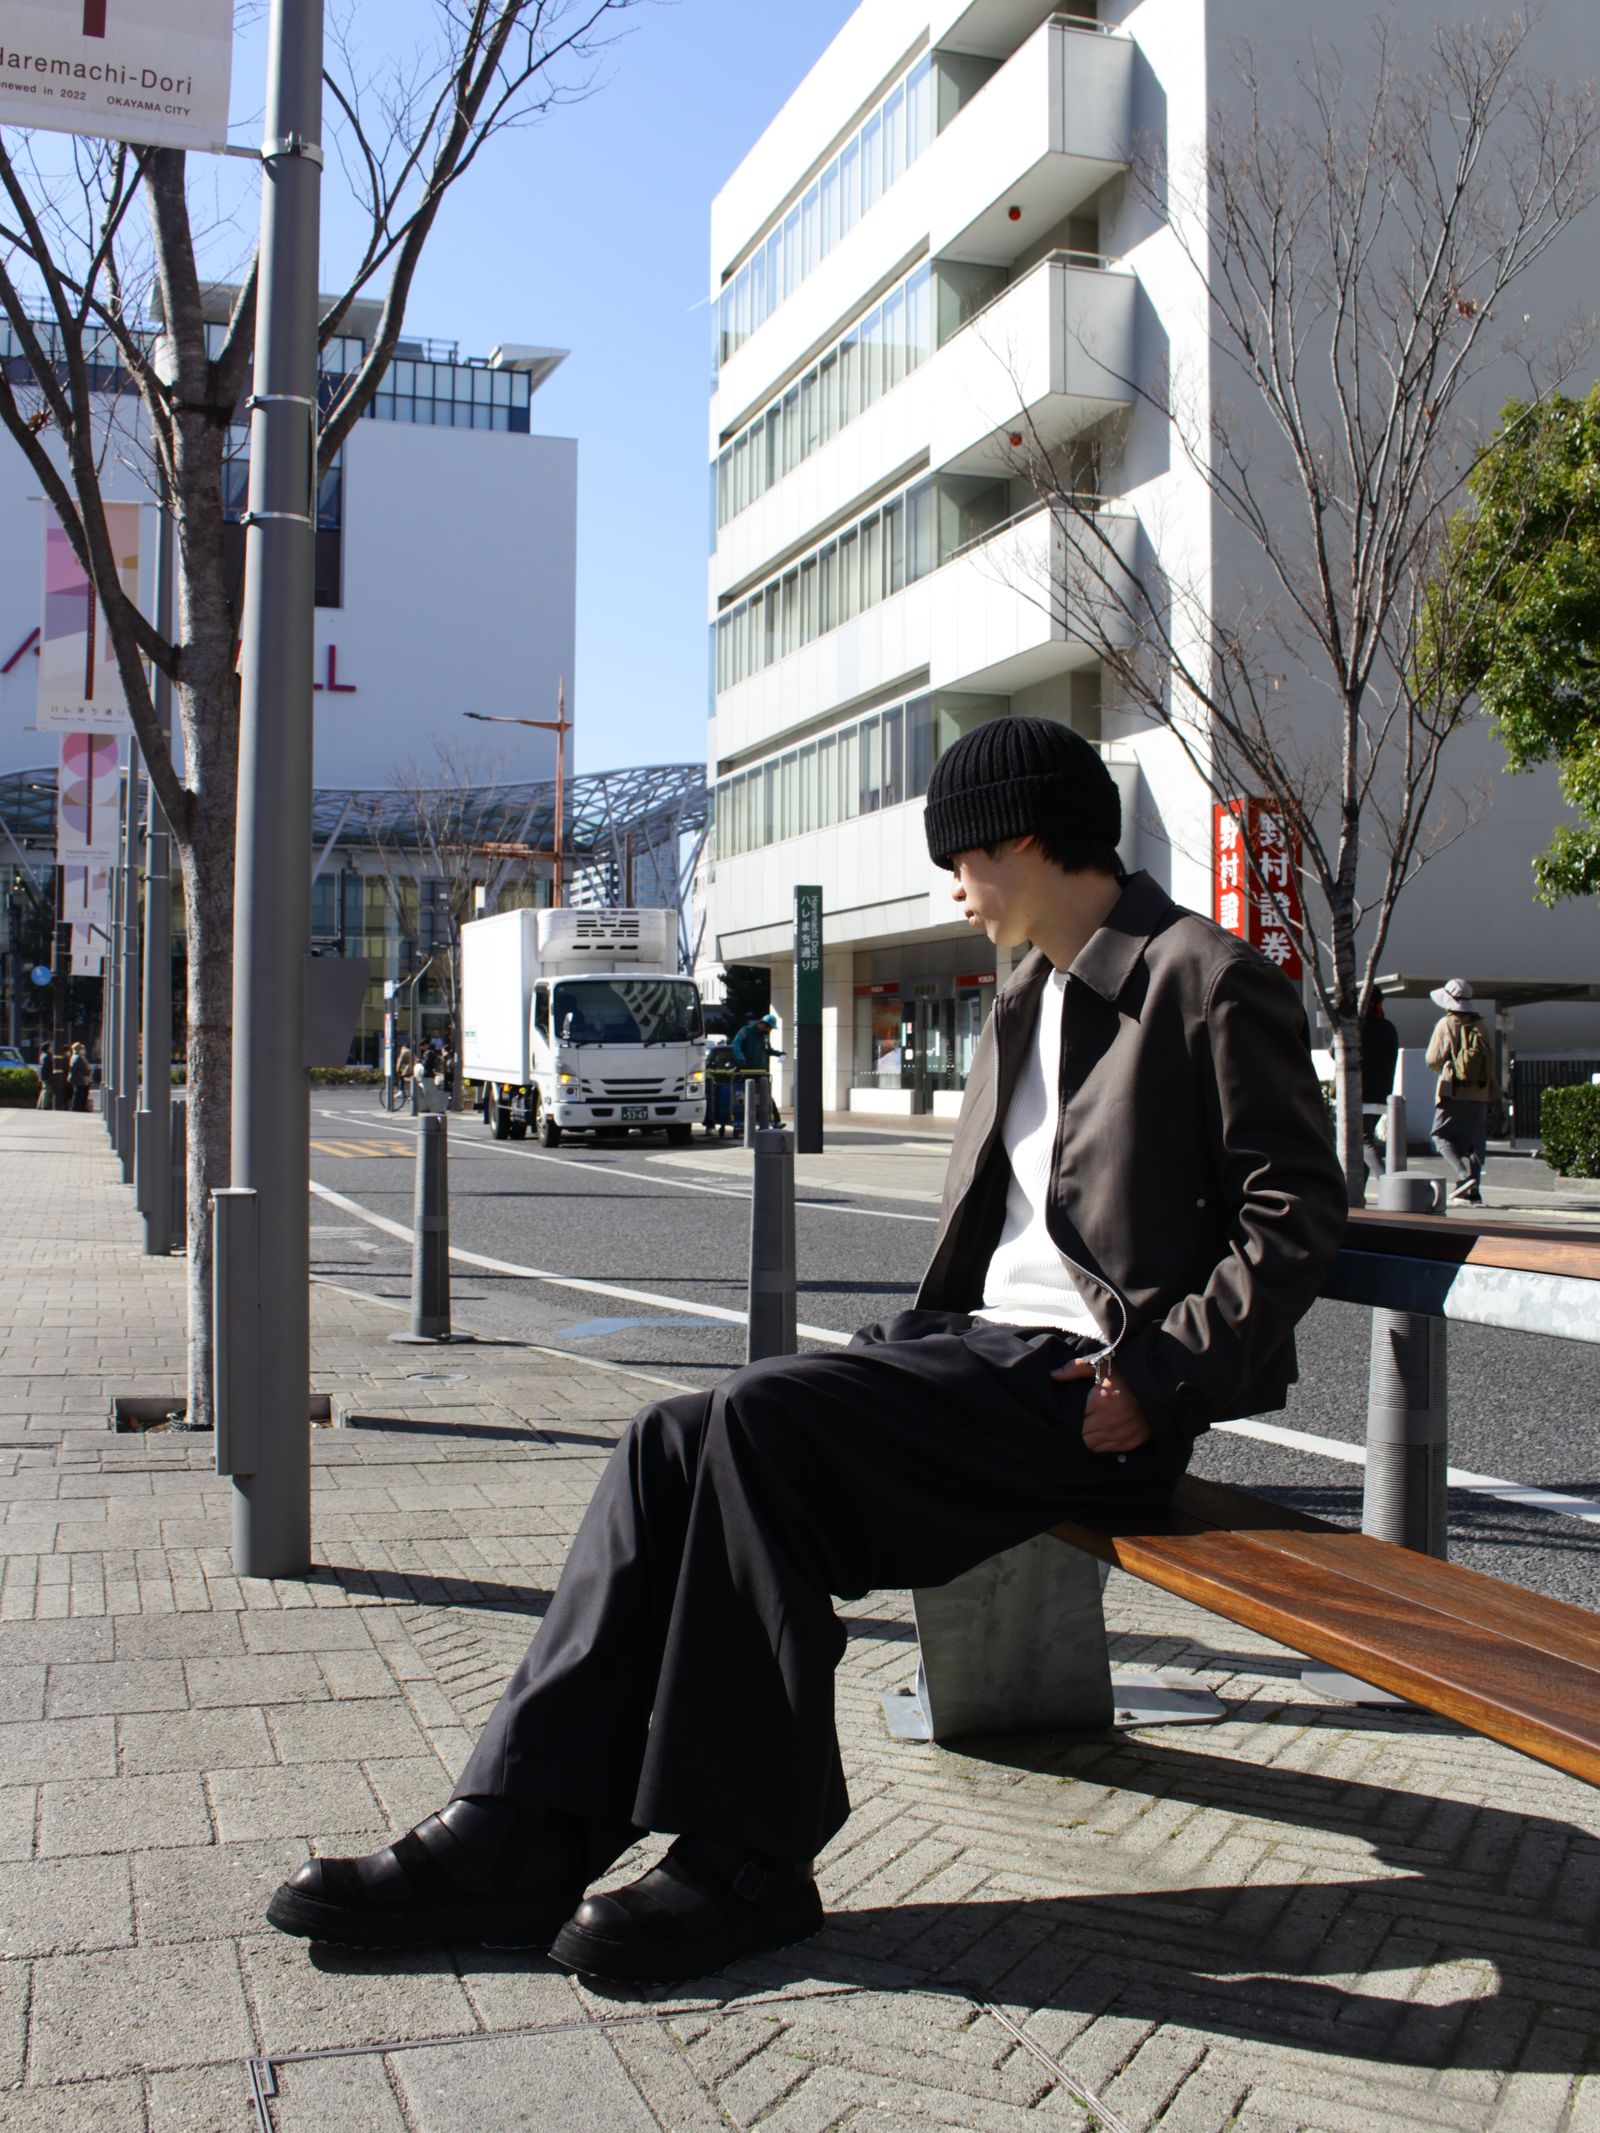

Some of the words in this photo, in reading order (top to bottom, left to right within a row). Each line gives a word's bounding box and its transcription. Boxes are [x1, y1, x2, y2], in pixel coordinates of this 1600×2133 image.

[43, 85, 54, 96] in
[60, 88, 87, 101] 2022
[106, 95, 161, 113] OKAYAMA
[164, 104, 191, 117] CITY
[1219, 813, 1240, 936] 野村證
